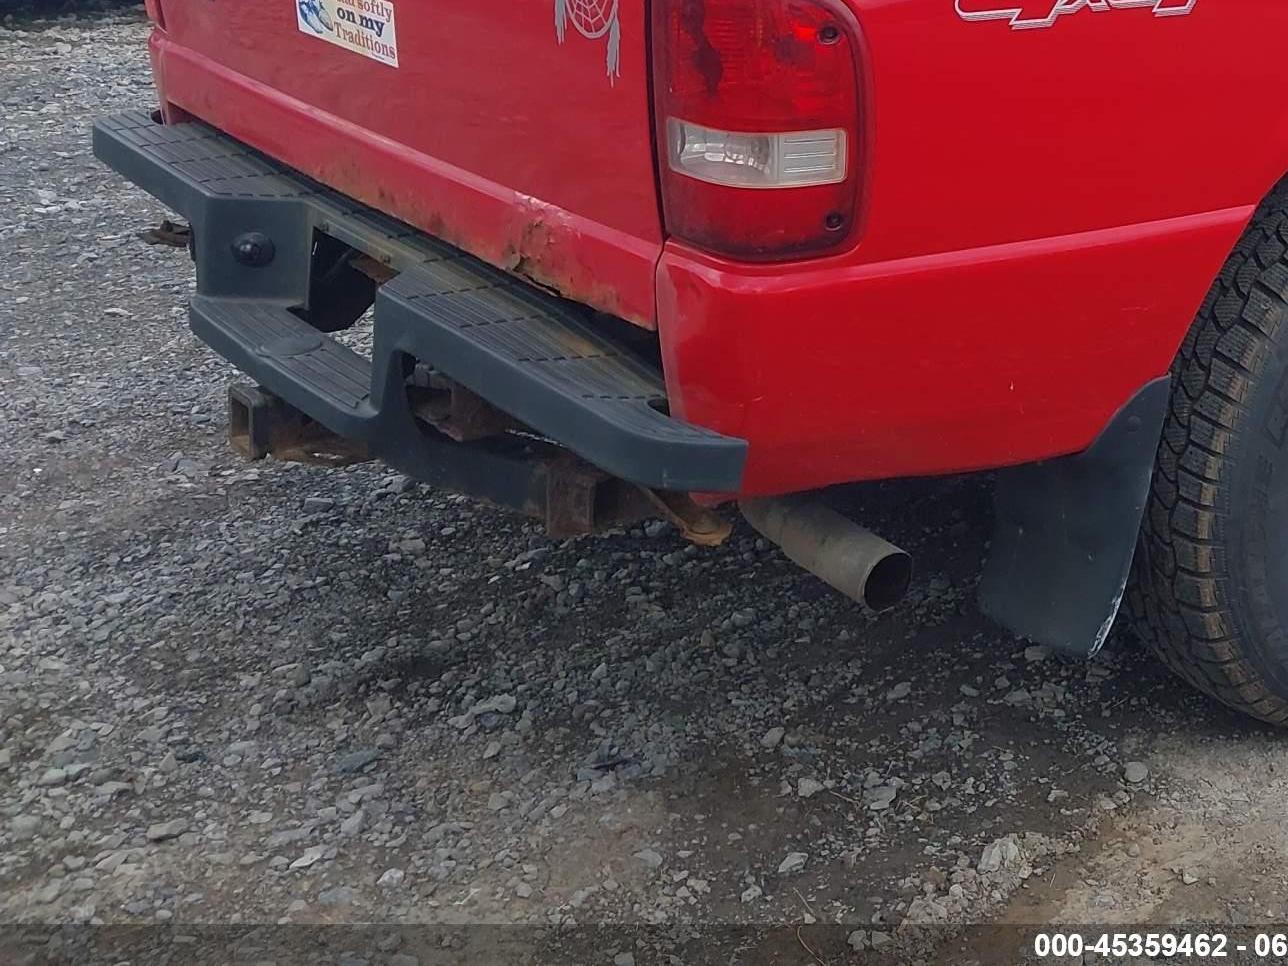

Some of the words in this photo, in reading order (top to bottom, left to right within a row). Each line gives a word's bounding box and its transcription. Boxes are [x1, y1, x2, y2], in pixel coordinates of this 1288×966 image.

[336, 7, 357, 25] on
[359, 14, 385, 38] my
[333, 21, 396, 60] Traditions
